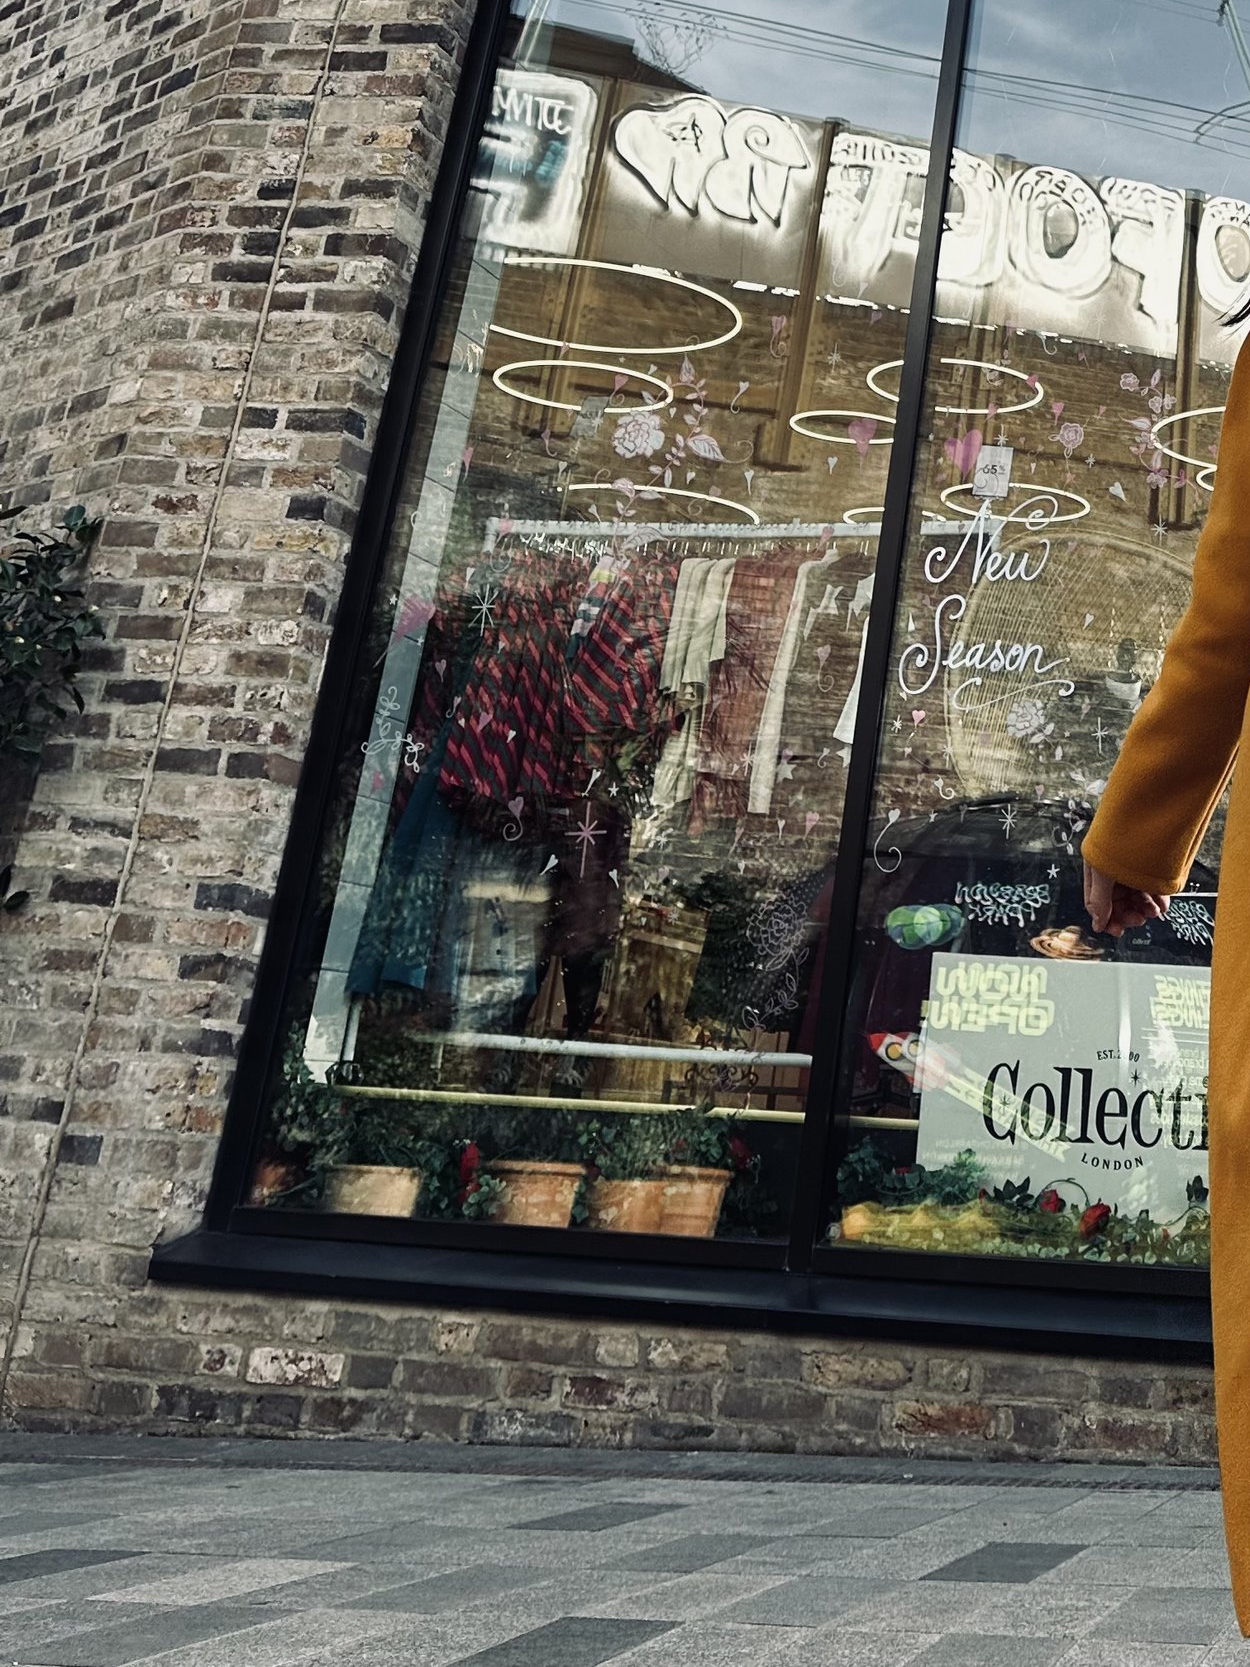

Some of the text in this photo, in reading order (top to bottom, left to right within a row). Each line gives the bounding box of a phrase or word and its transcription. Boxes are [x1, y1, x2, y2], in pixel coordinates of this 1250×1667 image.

[924, 495, 1058, 584] New
[898, 593, 1071, 696] Season
[1117, 1049, 1141, 1063] 200
[1081, 1152, 1145, 1171] LONDON
